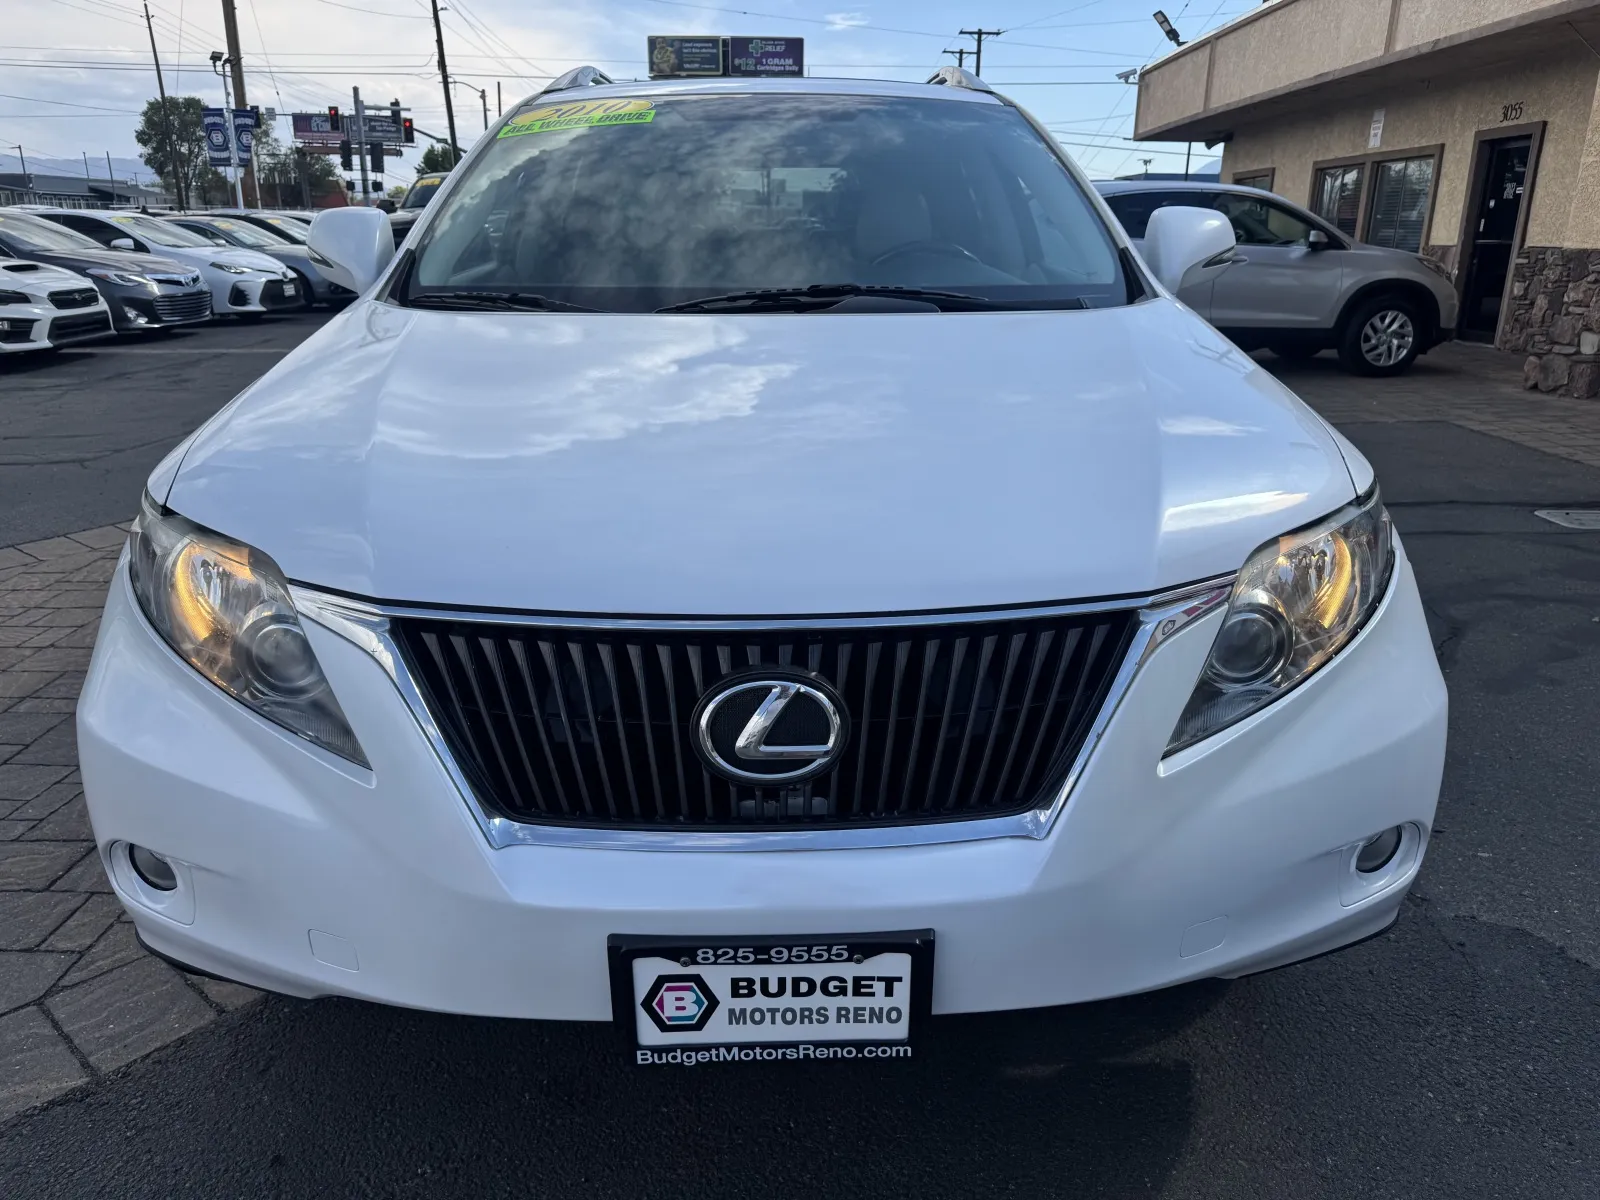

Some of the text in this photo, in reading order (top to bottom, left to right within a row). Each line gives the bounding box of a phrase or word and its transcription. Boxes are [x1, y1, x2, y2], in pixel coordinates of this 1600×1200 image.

[530, 100, 632, 122] 2010
[1500, 101, 1524, 123] 3055
[503, 111, 649, 135] ALL WHEEL DRIVE
[695, 945, 849, 964] 825-9555
[730, 976, 903, 998] BUDGET
[727, 1006, 903, 1026] MOTORS RENO
[636, 1044, 912, 1065] BudgetMotorsReno.com
